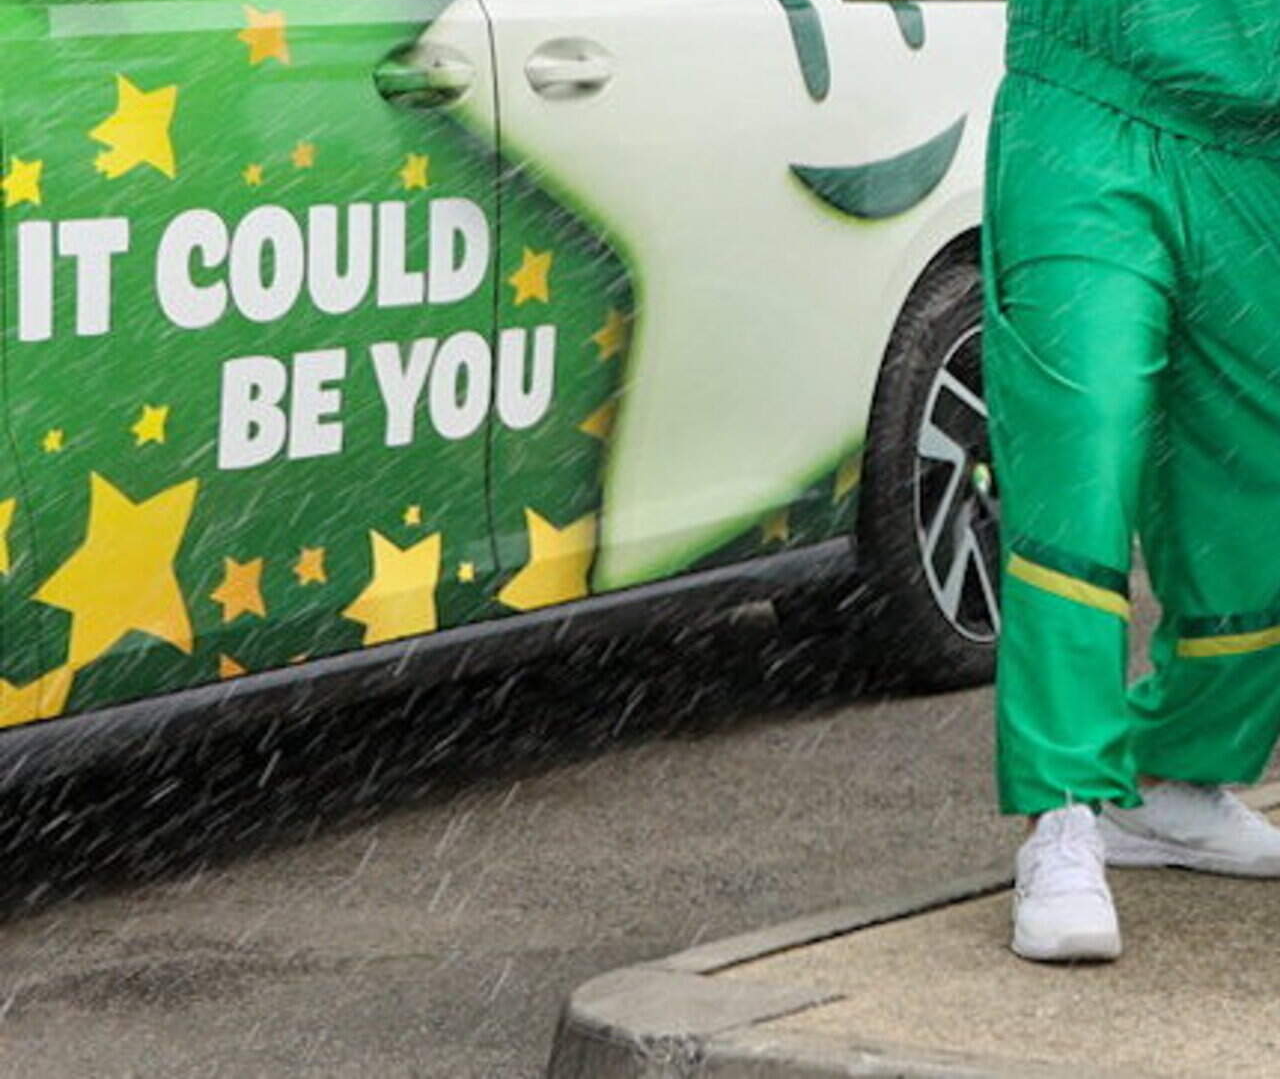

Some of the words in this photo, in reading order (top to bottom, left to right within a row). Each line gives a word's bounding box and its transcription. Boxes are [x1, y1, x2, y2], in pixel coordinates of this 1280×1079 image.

[17, 217, 130, 342] IT
[155, 197, 491, 330] COULD
[217, 347, 348, 470] BE
[370, 324, 557, 447] YOU
